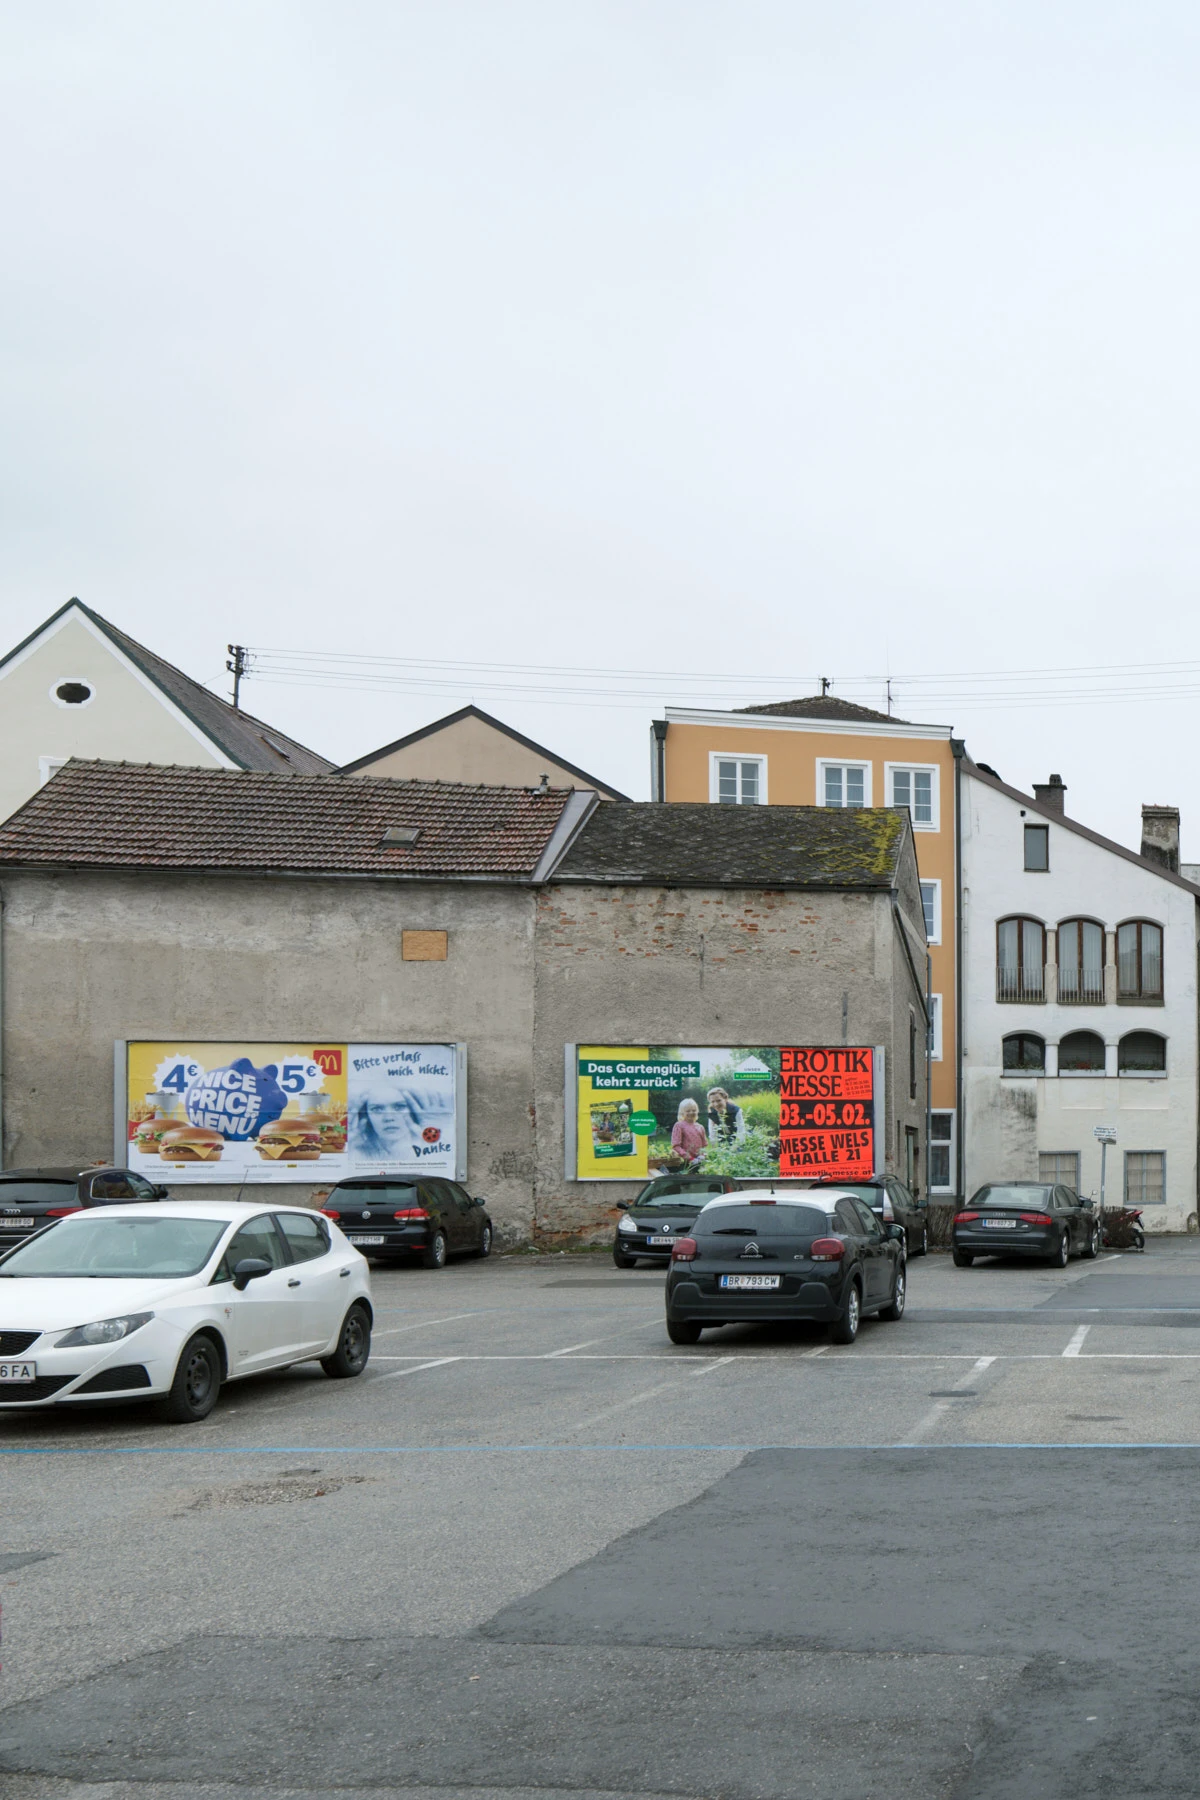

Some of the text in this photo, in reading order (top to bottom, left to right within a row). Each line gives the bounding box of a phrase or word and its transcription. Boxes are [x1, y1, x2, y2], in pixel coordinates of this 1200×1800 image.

[353, 1051, 421, 1071] Bitte verlass
[388, 1064, 449, 1076] mich nicht.
[588, 1063, 696, 1076] Das Gartenglück
[780, 1050, 869, 1072] EROTIK
[198, 1069, 257, 1093] NICE
[596, 1076, 678, 1087] kehrt zurück
[780, 1075, 843, 1097] MESSE
[189, 1089, 262, 1117] PRICE
[189, 1109, 257, 1135] MENÜ
[780, 1103, 870, 1126] 03.-05.02.
[412, 1142, 452, 1157] Danke
[780, 1131, 869, 1154] MESSE WELS
[790, 1148, 861, 1166] HALLE 21
[728, 1276, 777, 1285] BR 793 CW
[11, 1365, 30, 1377] FA
